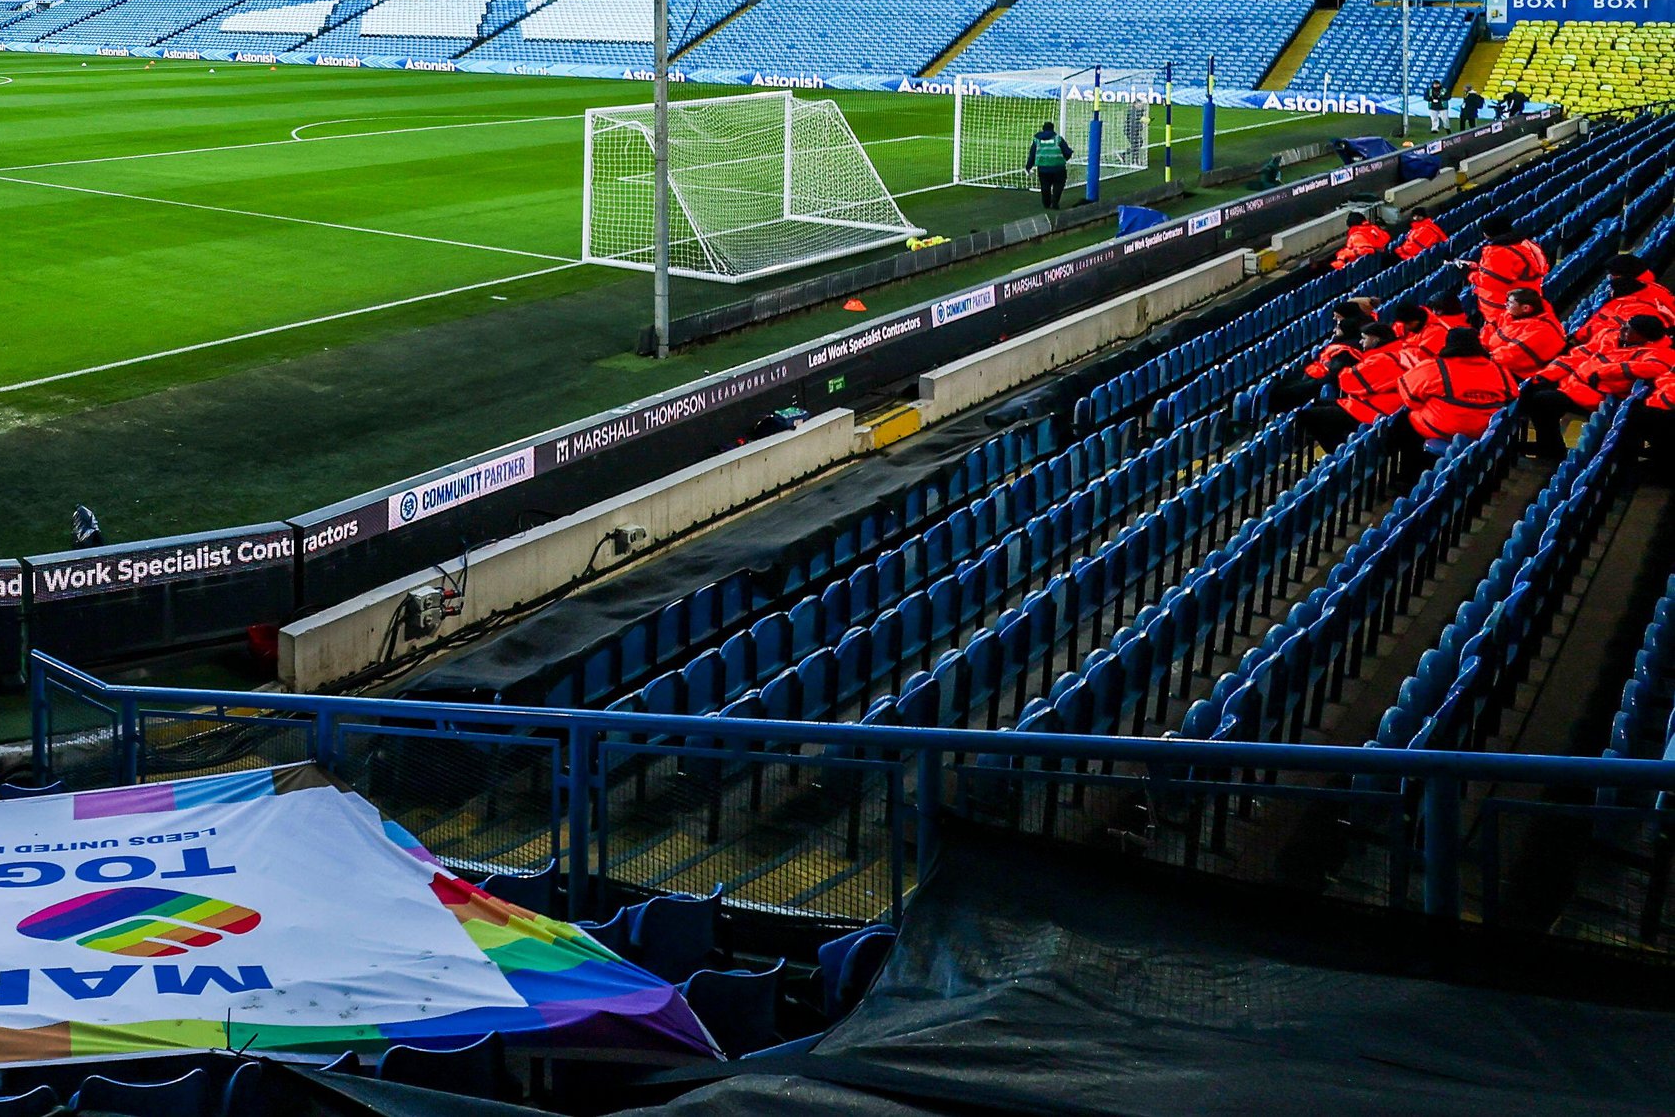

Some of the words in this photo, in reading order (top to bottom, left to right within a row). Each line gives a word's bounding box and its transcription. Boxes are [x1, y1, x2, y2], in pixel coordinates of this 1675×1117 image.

[95, 46, 129, 57] Astonish
[162, 48, 200, 60] Astonish
[235, 51, 276, 64] Astonish
[315, 53, 361, 67] Astonish
[404, 57, 456, 72] Astonish
[622, 68, 685, 83] Astosh
[751, 71, 823, 89] Astonish
[1262, 90, 1376, 114] Astonish
[1011, 272, 1043, 295] MARSHALL
[1044, 262, 1075, 283] THOMPSON
[946, 297, 972, 318] COMMUNITY
[972, 290, 992, 310] PARTNER
[808, 348, 828, 369] Lead
[827, 340, 848, 362] Work
[848, 326, 882, 355] Specialist
[881, 316, 921, 340] Contractors
[573, 416, 640, 457] MARSHALL
[643, 392, 707, 430] THOMPSON
[710, 373, 767, 404] LEADWORK
[770, 366, 788, 384] LTD
[421, 468, 482, 511] COMMUNITY
[483, 455, 526, 488] PARTNER
[43, 562, 111, 593] Work
[118, 545, 232, 584] Specialist
[237, 518, 359, 564] Contractors
[128, 827, 217, 846] LEEDS
[14, 838, 119, 854] UNITED
